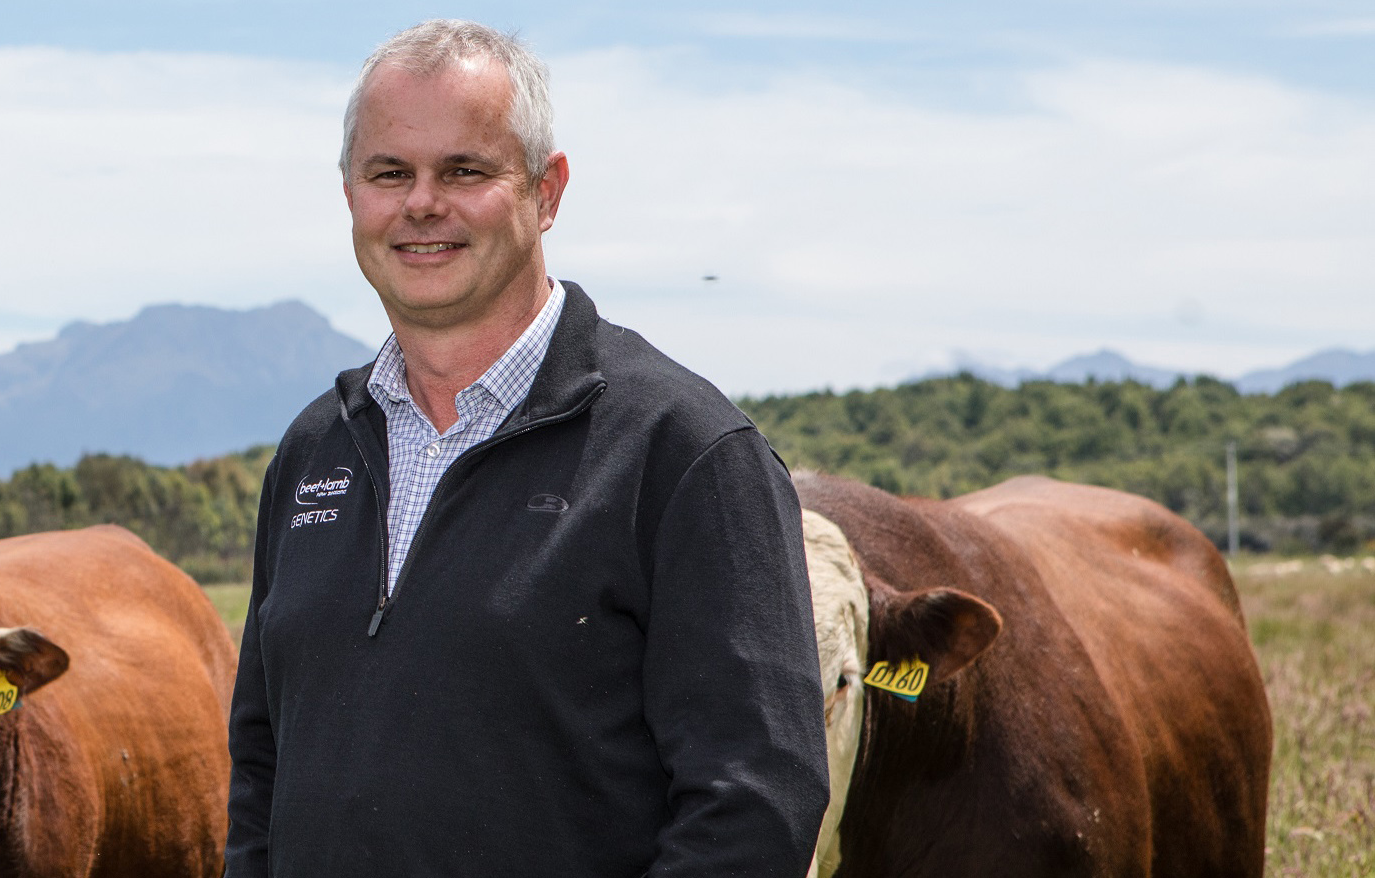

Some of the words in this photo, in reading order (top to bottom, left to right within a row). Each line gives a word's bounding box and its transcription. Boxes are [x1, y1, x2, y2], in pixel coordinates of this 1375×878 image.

[299, 476, 350, 495] beef+lamb
[291, 509, 339, 528] GENETICS
[871, 666, 924, 691] 0160
